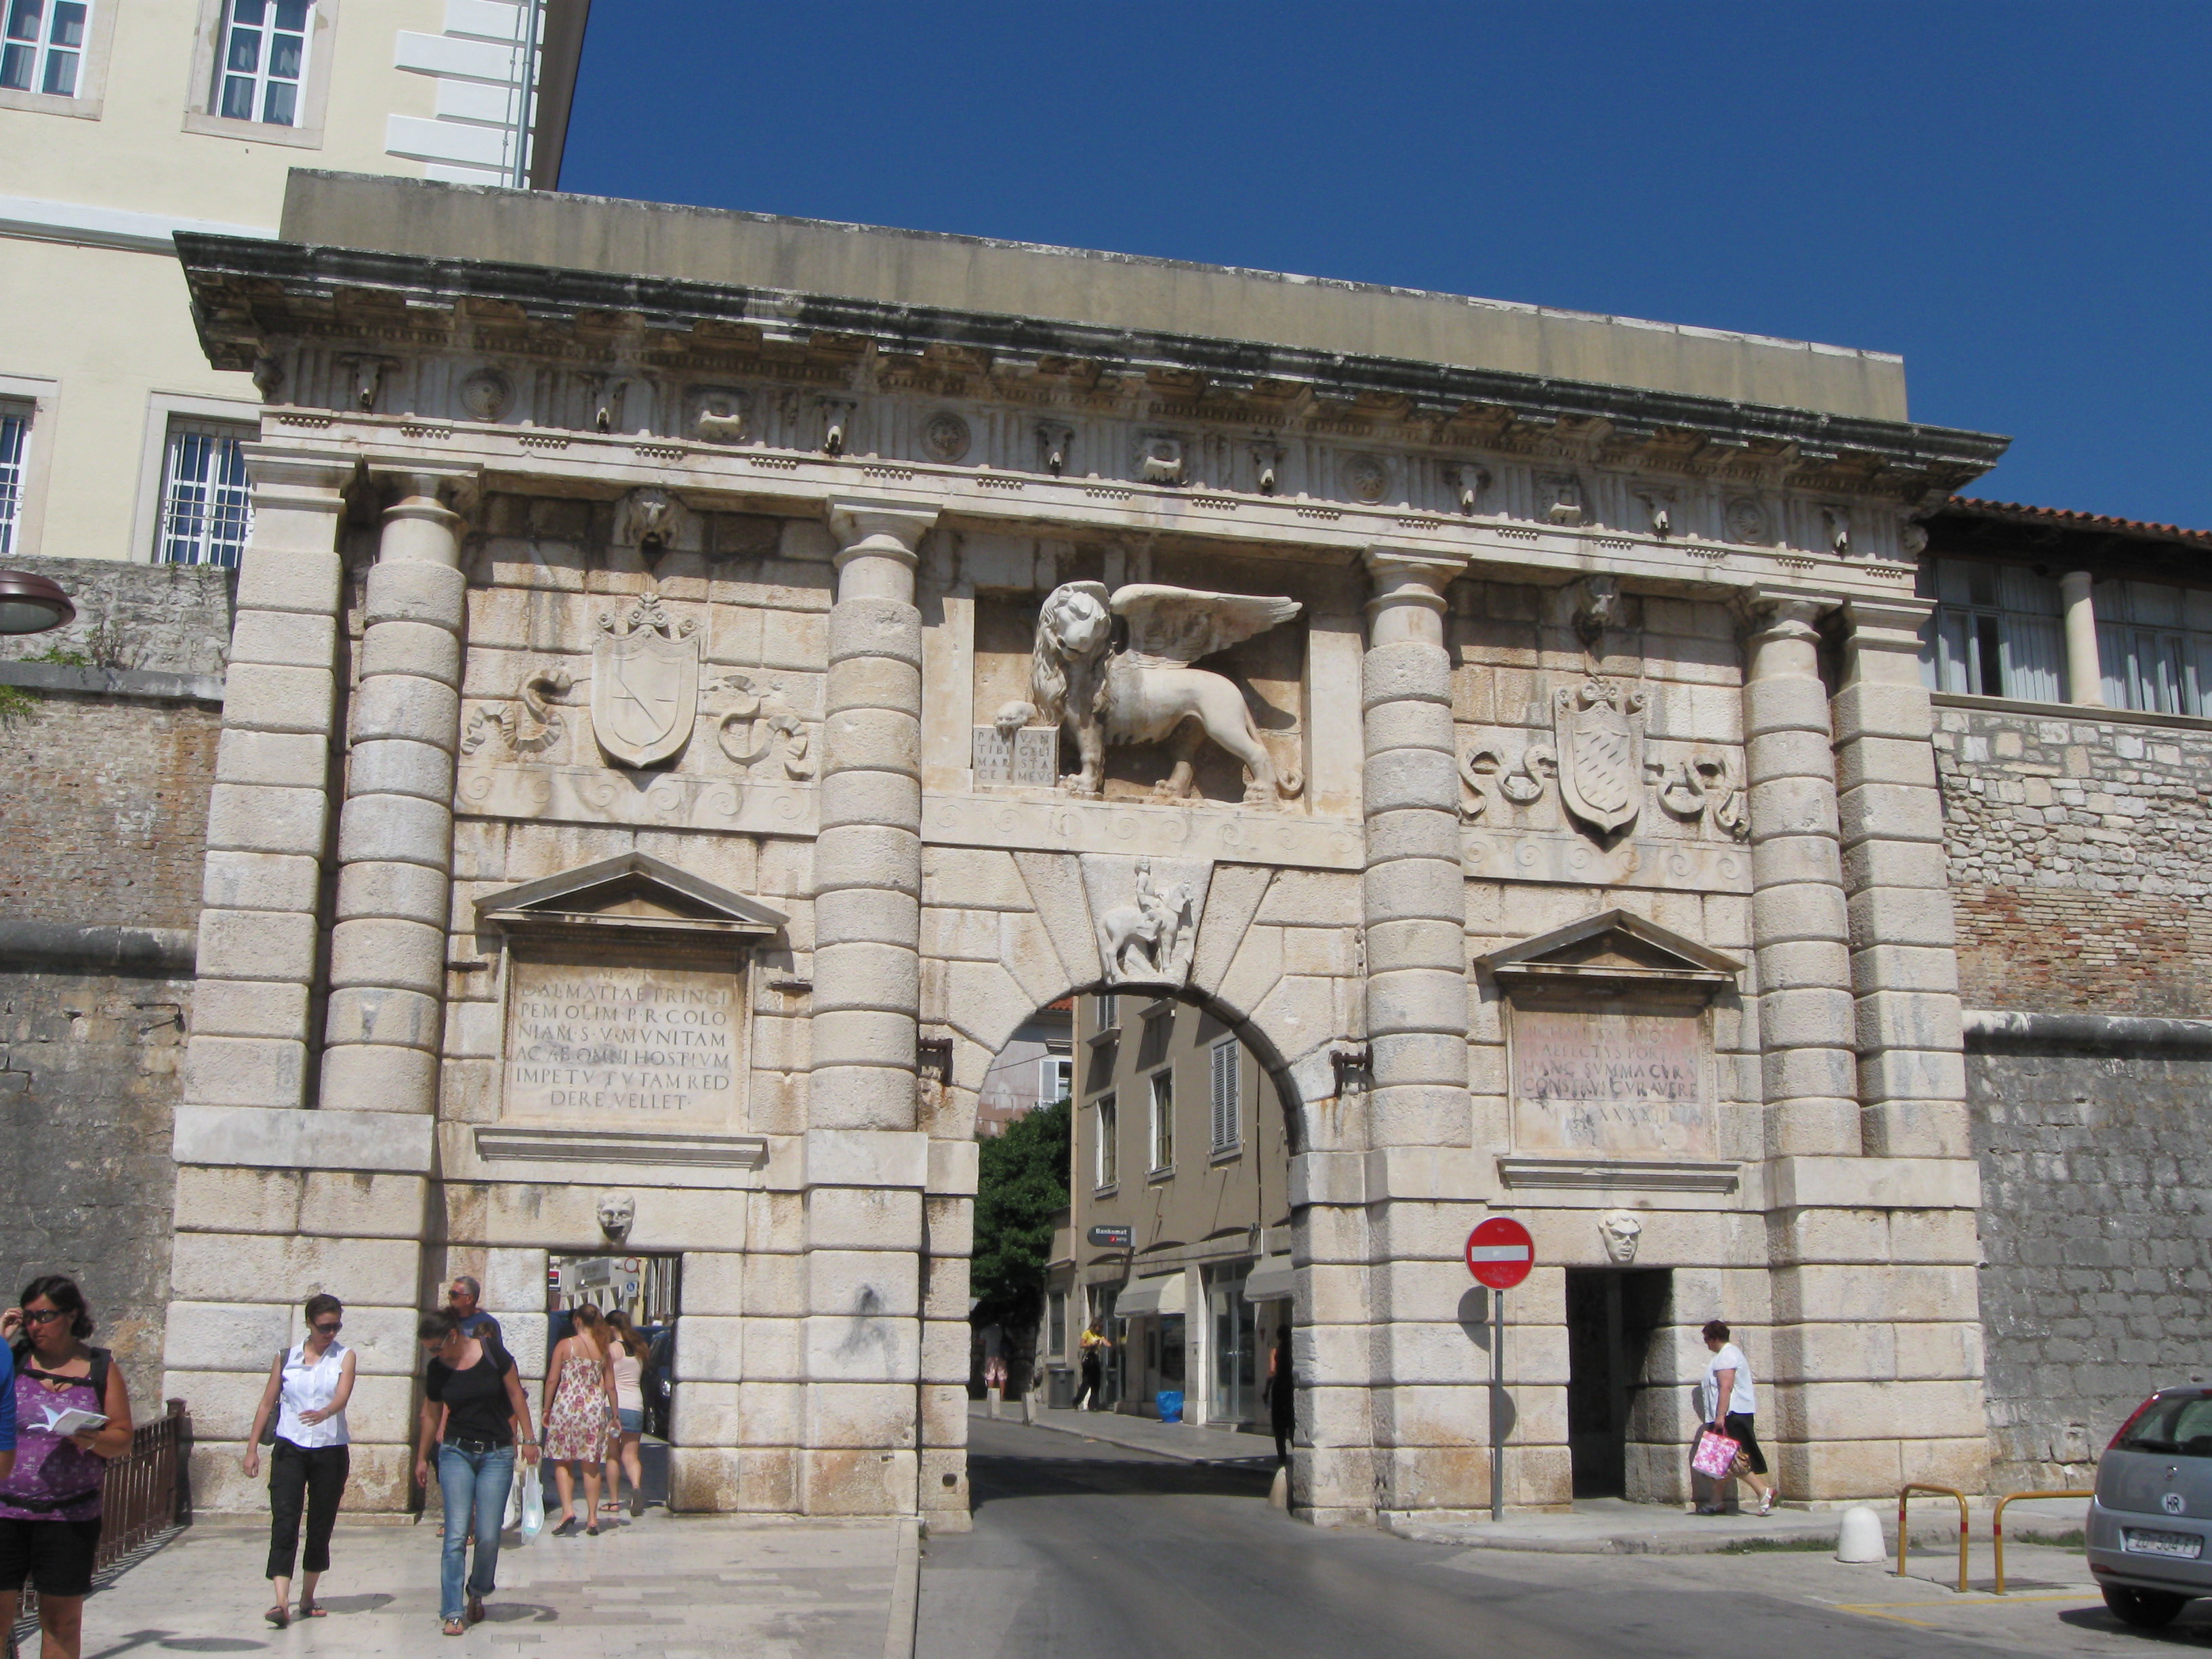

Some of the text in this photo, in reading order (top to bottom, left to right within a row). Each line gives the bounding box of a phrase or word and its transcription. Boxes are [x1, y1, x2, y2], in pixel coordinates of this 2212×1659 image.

[977, 745, 1010, 755] TIBI
[977, 758, 1009, 767] MAR
[1021, 759, 1048, 769] STA
[655, 987, 726, 1005] PRINCI
[521, 1003, 557, 1019] PEM
[666, 1010, 726, 1026] COLO
[516, 1046, 542, 1061] AC
[689, 1074, 730, 1090] RED
[552, 1090, 605, 1107] DERE
[2166, 1496, 2180, 1512] HR
